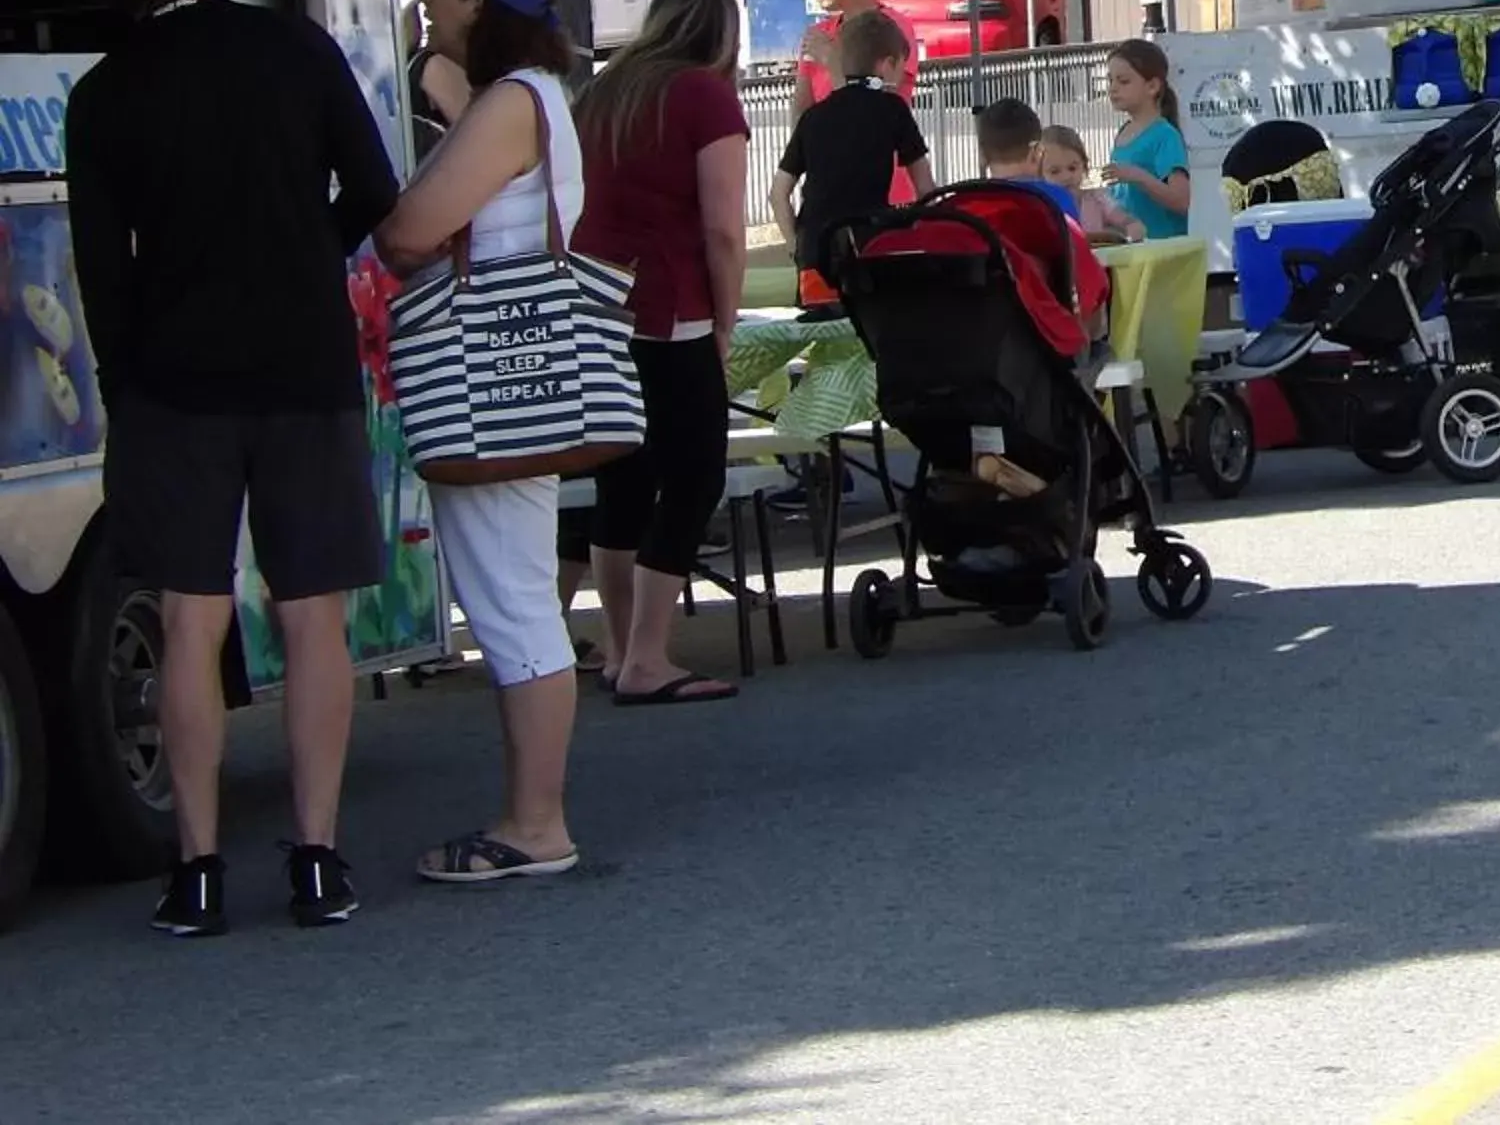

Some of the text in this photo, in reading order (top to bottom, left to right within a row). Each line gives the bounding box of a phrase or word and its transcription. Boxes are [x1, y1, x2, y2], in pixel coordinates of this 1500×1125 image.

[498, 302, 538, 321] EAT.
[488, 325, 553, 349] BEACH.
[496, 354, 552, 374] SLEEP.
[490, 380, 562, 402] REPEAT.
